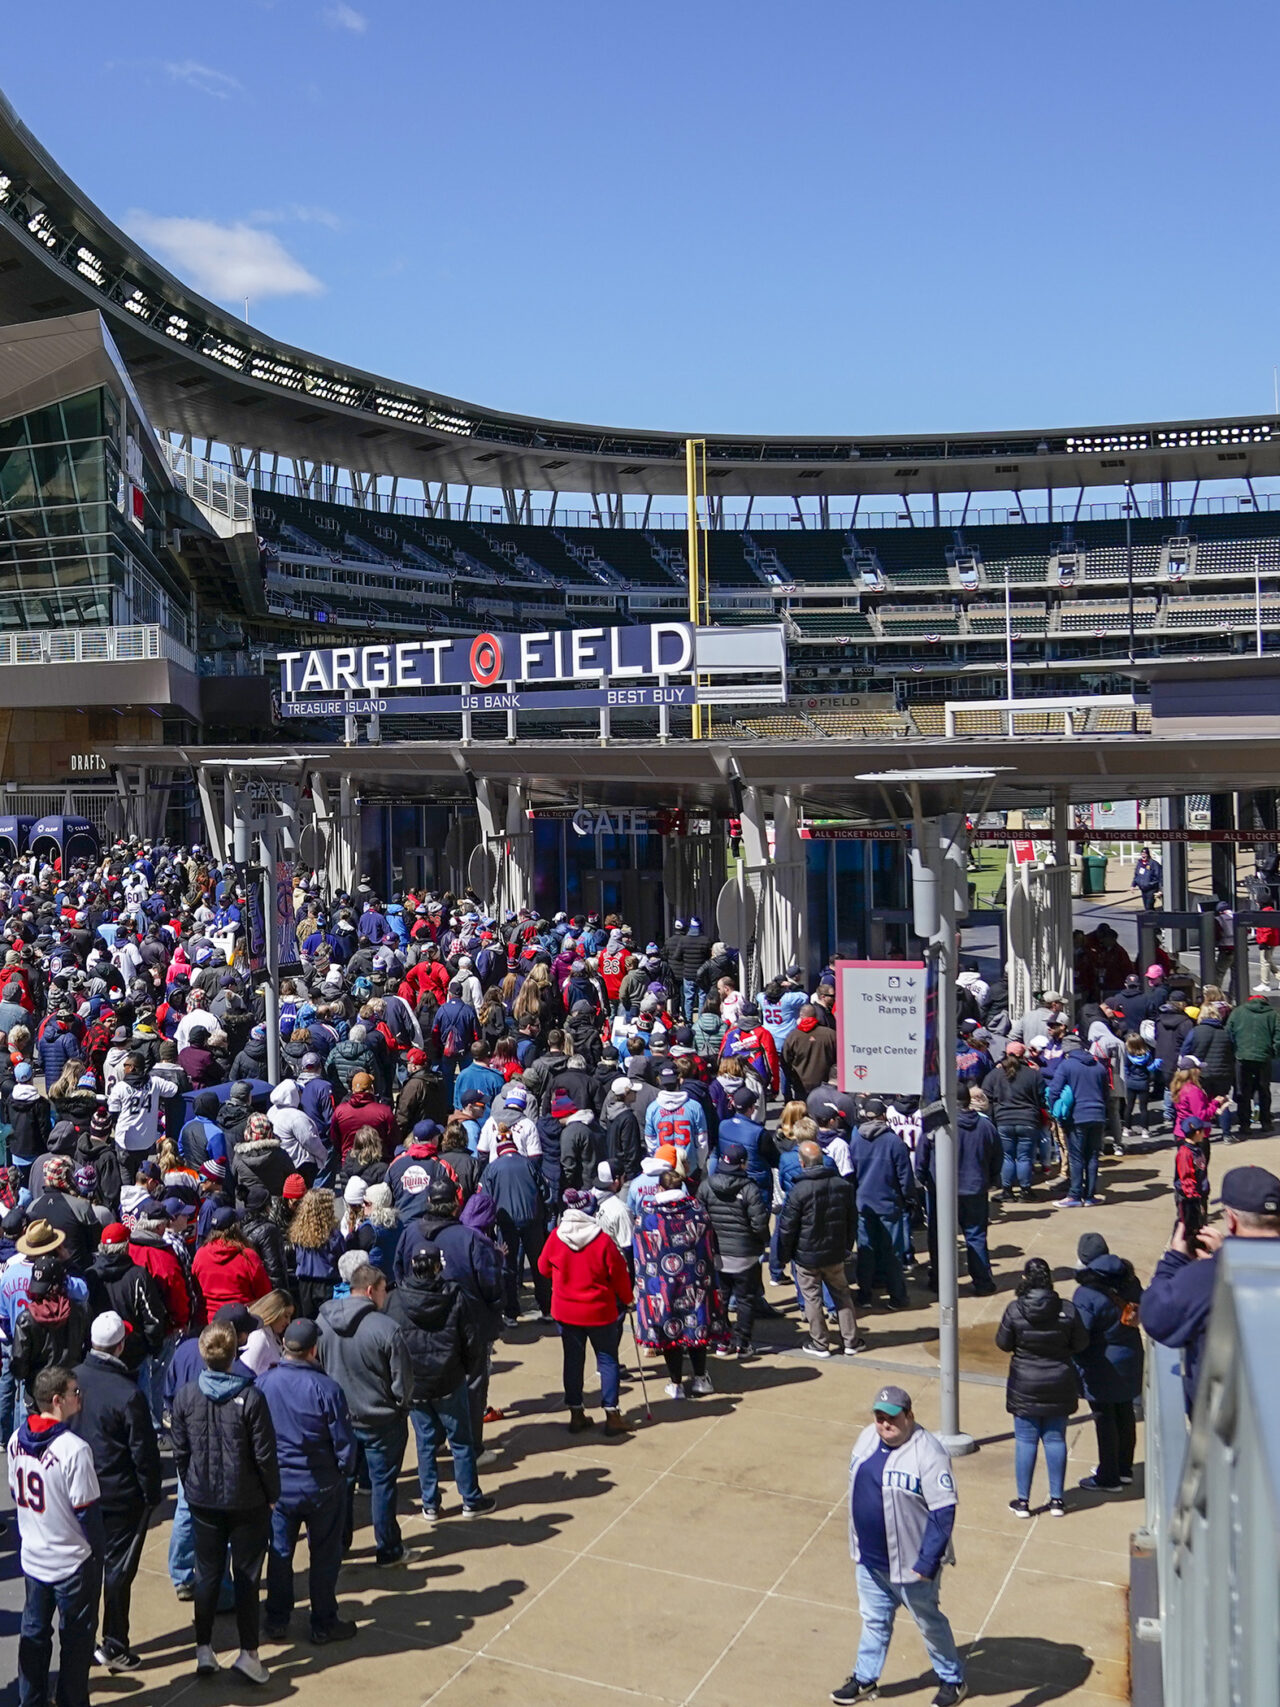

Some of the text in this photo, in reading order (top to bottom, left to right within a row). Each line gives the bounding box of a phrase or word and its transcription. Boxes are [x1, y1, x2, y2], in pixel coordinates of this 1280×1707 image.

[277, 622, 693, 692] TARGET FIELD
[461, 695, 520, 708] US BANK
[607, 688, 686, 704] BEST BUY
[820, 697, 860, 707] FIELD
[287, 700, 387, 715] TREASURE ISLAND
[572, 808, 648, 835] GATE
[861, 993, 873, 1002] To
[764, 1009, 782, 1025] 25
[878, 1006, 917, 1016] Ramp B
[851, 1045, 918, 1056] Target Center
[129, 1094, 152, 1114] 24
[888, 1116, 921, 1127] POLANC
[657, 1120, 690, 1147] 25
[638, 1184, 658, 1197] MAUE
[16, 1467, 46, 1514] 19
